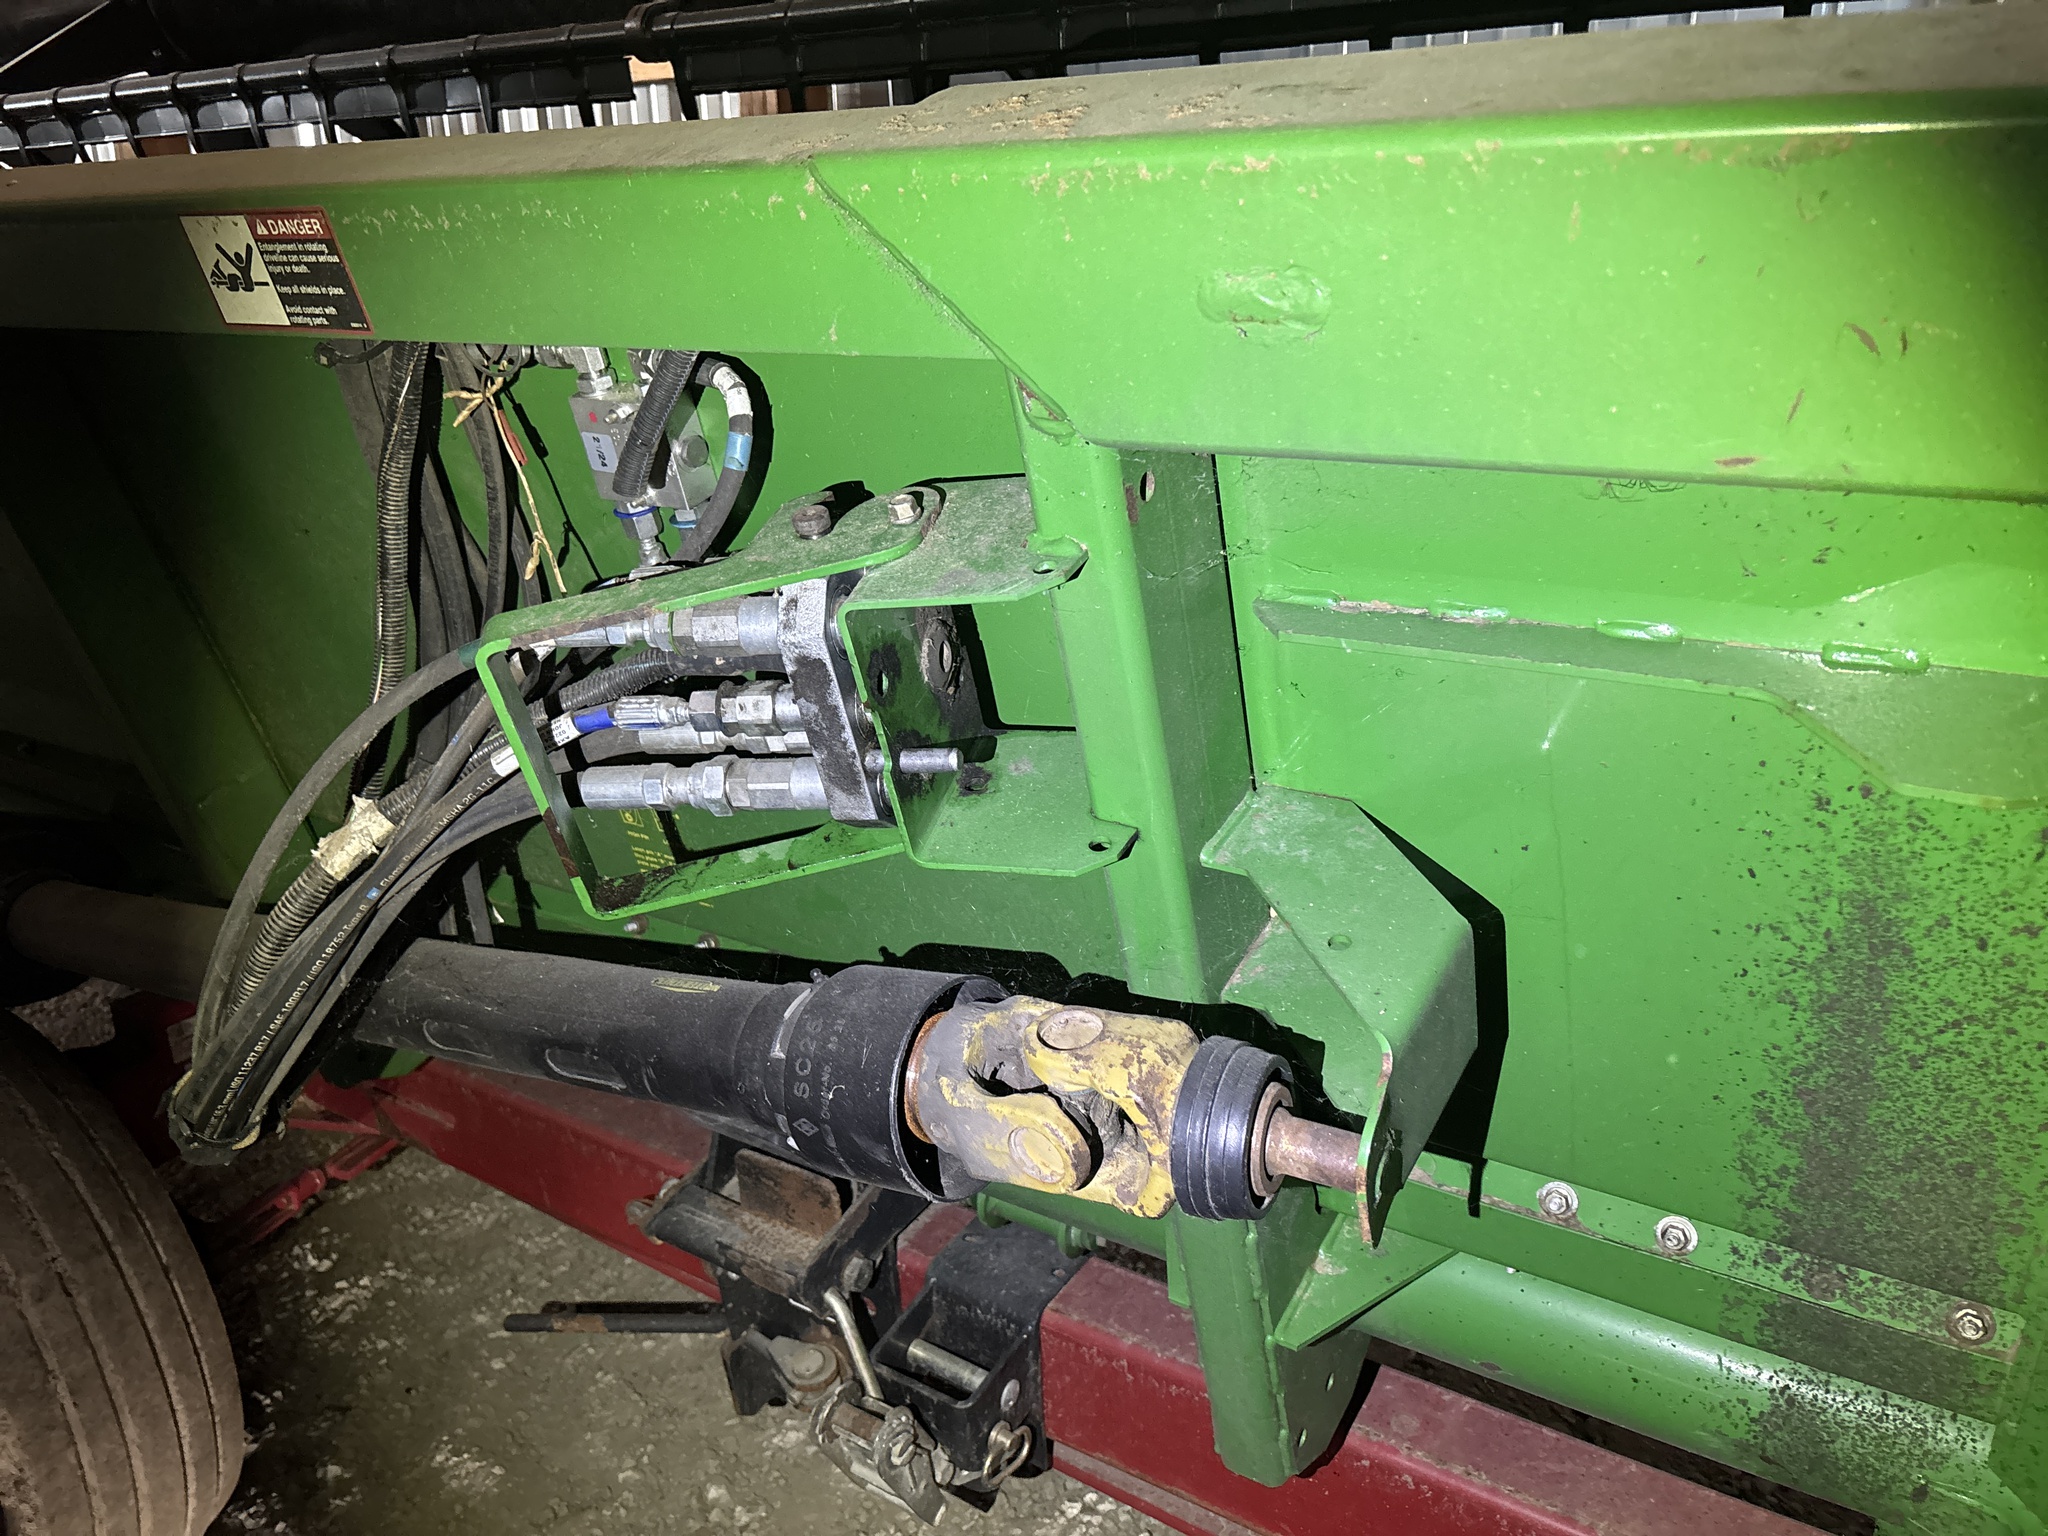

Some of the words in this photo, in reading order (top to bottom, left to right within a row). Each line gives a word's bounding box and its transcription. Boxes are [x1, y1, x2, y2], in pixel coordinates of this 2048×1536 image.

[267, 219, 324, 235] DANGER
[259, 242, 297, 253] Entanglement
[298, 243, 304, 251] in
[305, 242, 328, 253] rotating
[263, 253, 287, 262] driveline
[319, 254, 340, 263] serious
[267, 264, 285, 275] injury
[292, 264, 311, 273] death.
[276, 284, 292, 295] Keep
[300, 285, 320, 294] shields
[321, 286, 328, 294] in
[328, 286, 346, 296] place.
[285, 305, 302, 314] Avoid
[303, 306, 324, 314] contact
[324, 306, 338, 315] with
[290, 316, 313, 326] rotating
[313, 317, 329, 326] parts.
[438, 803, 464, 826] MSHA
[238, 1052, 259, 1076] 11237
[322, 930, 346, 959] 18752
